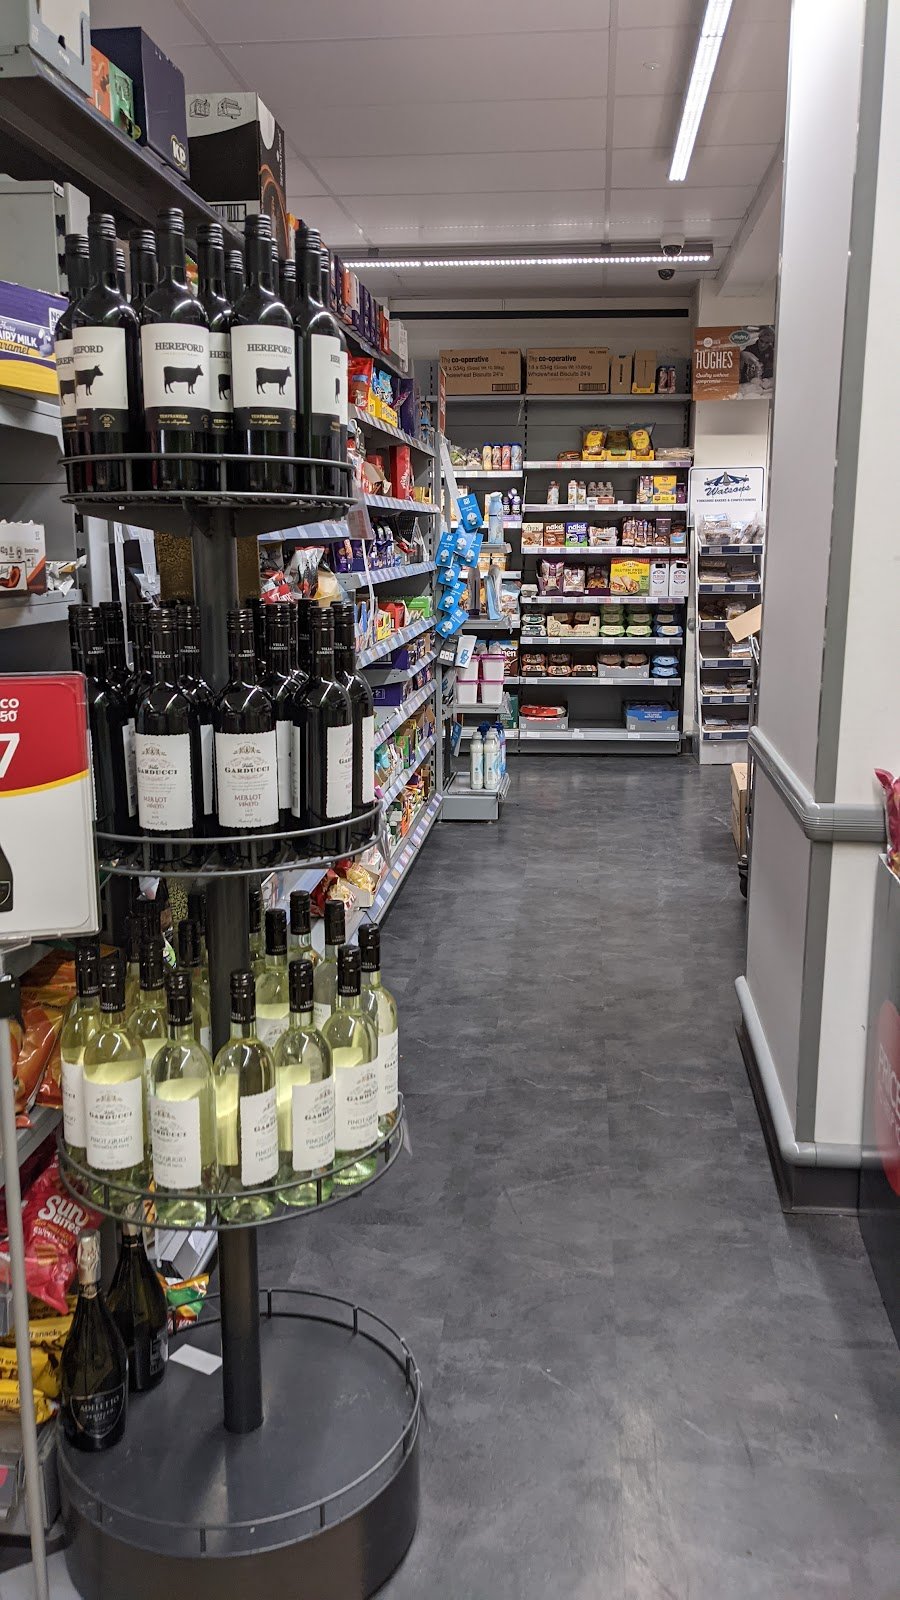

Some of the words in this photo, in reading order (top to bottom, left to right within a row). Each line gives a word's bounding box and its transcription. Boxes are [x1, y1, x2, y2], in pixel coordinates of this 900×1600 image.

[17, 333, 38, 348] MILK
[155, 342, 204, 353] HEREFORD
[247, 344, 292, 355] HEREFORD
[452, 356, 489, 364] co-operative
[539, 355, 576, 363] co-operative
[696, 351, 733, 369] HUGHES
[704, 485, 751, 497] Watsons
[224, 766, 270, 774] GARDUCCI
[37, 1194, 89, 1227] Sun
